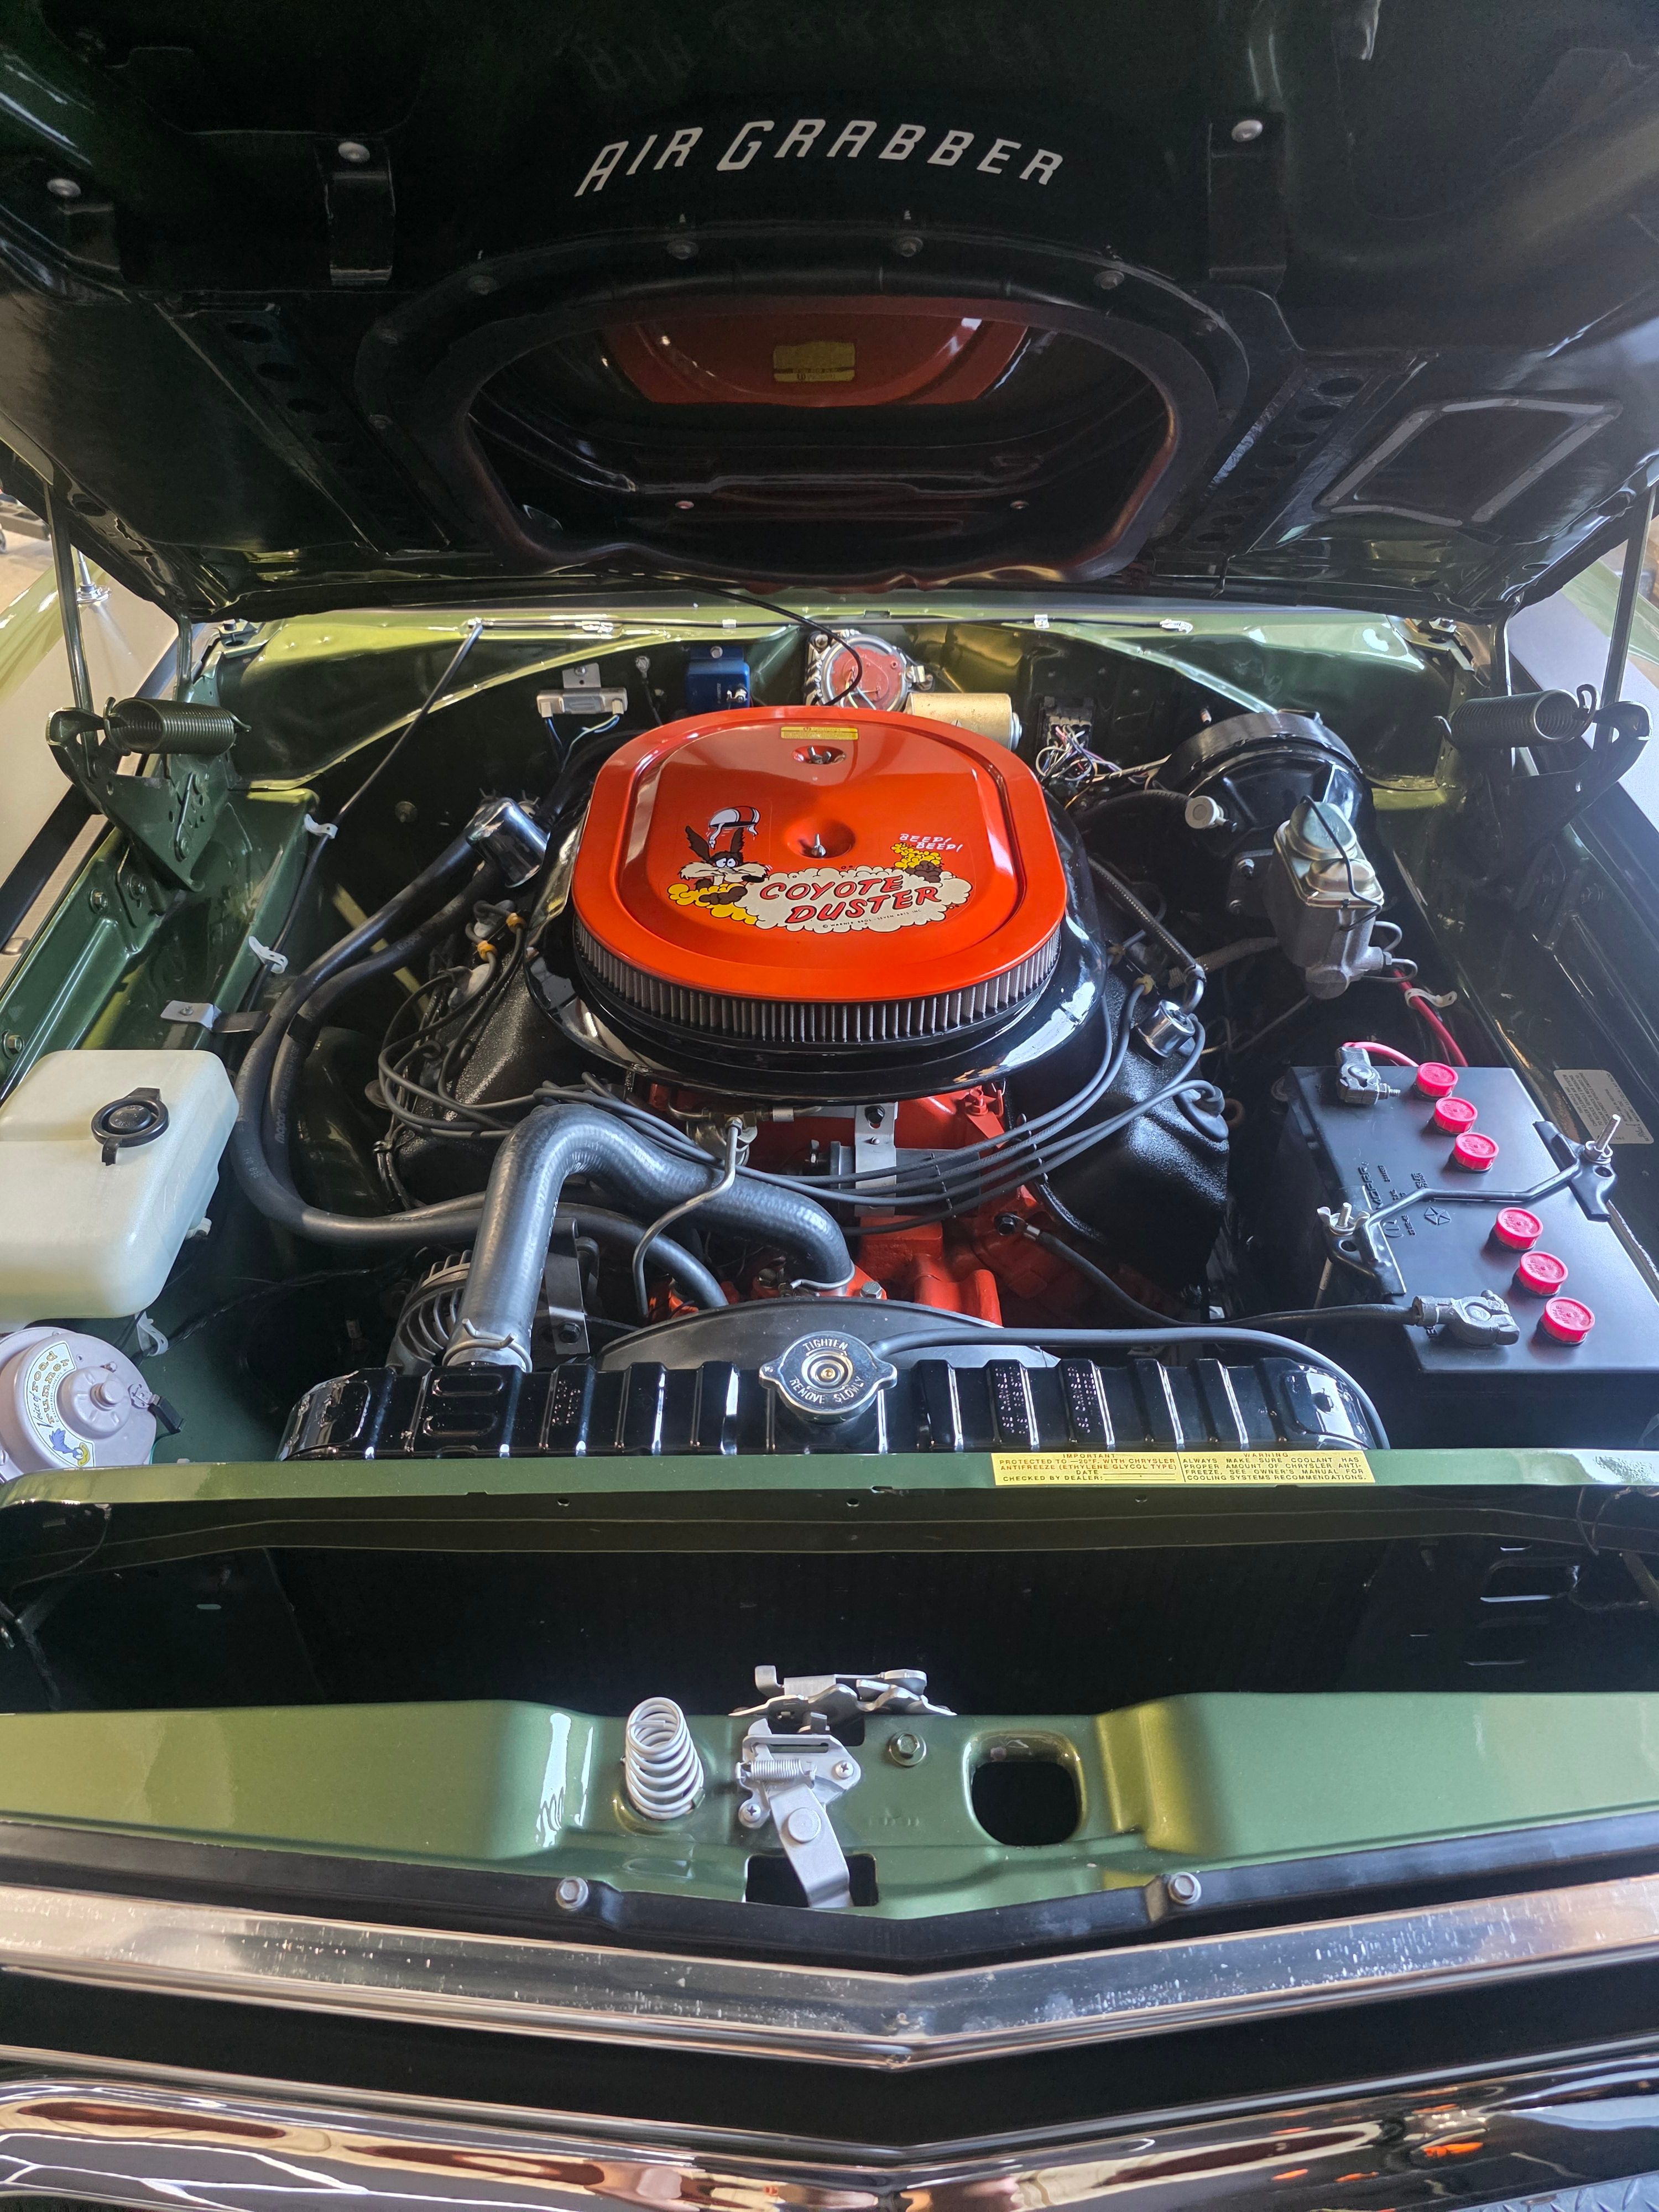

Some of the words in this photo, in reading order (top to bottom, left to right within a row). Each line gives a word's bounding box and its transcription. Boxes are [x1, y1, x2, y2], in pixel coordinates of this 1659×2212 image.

[575, 127, 703, 196] AIR
[716, 118, 1064, 185] GRABBER
[899, 833, 952, 844] BEEP!
[916, 842, 963, 852] BEEP!
[760, 875, 904, 901] COYOTE
[785, 886, 940, 924] DUSTER
[802, 1338, 848, 1352] TIGHTEN
[32, 1350, 58, 1392] road
[42, 1359, 70, 1424] runner
[790, 1378, 825, 1404] REMOVE
[833, 1376, 865, 1403] SLOWLY
[32, 1403, 54, 1428] Voice
